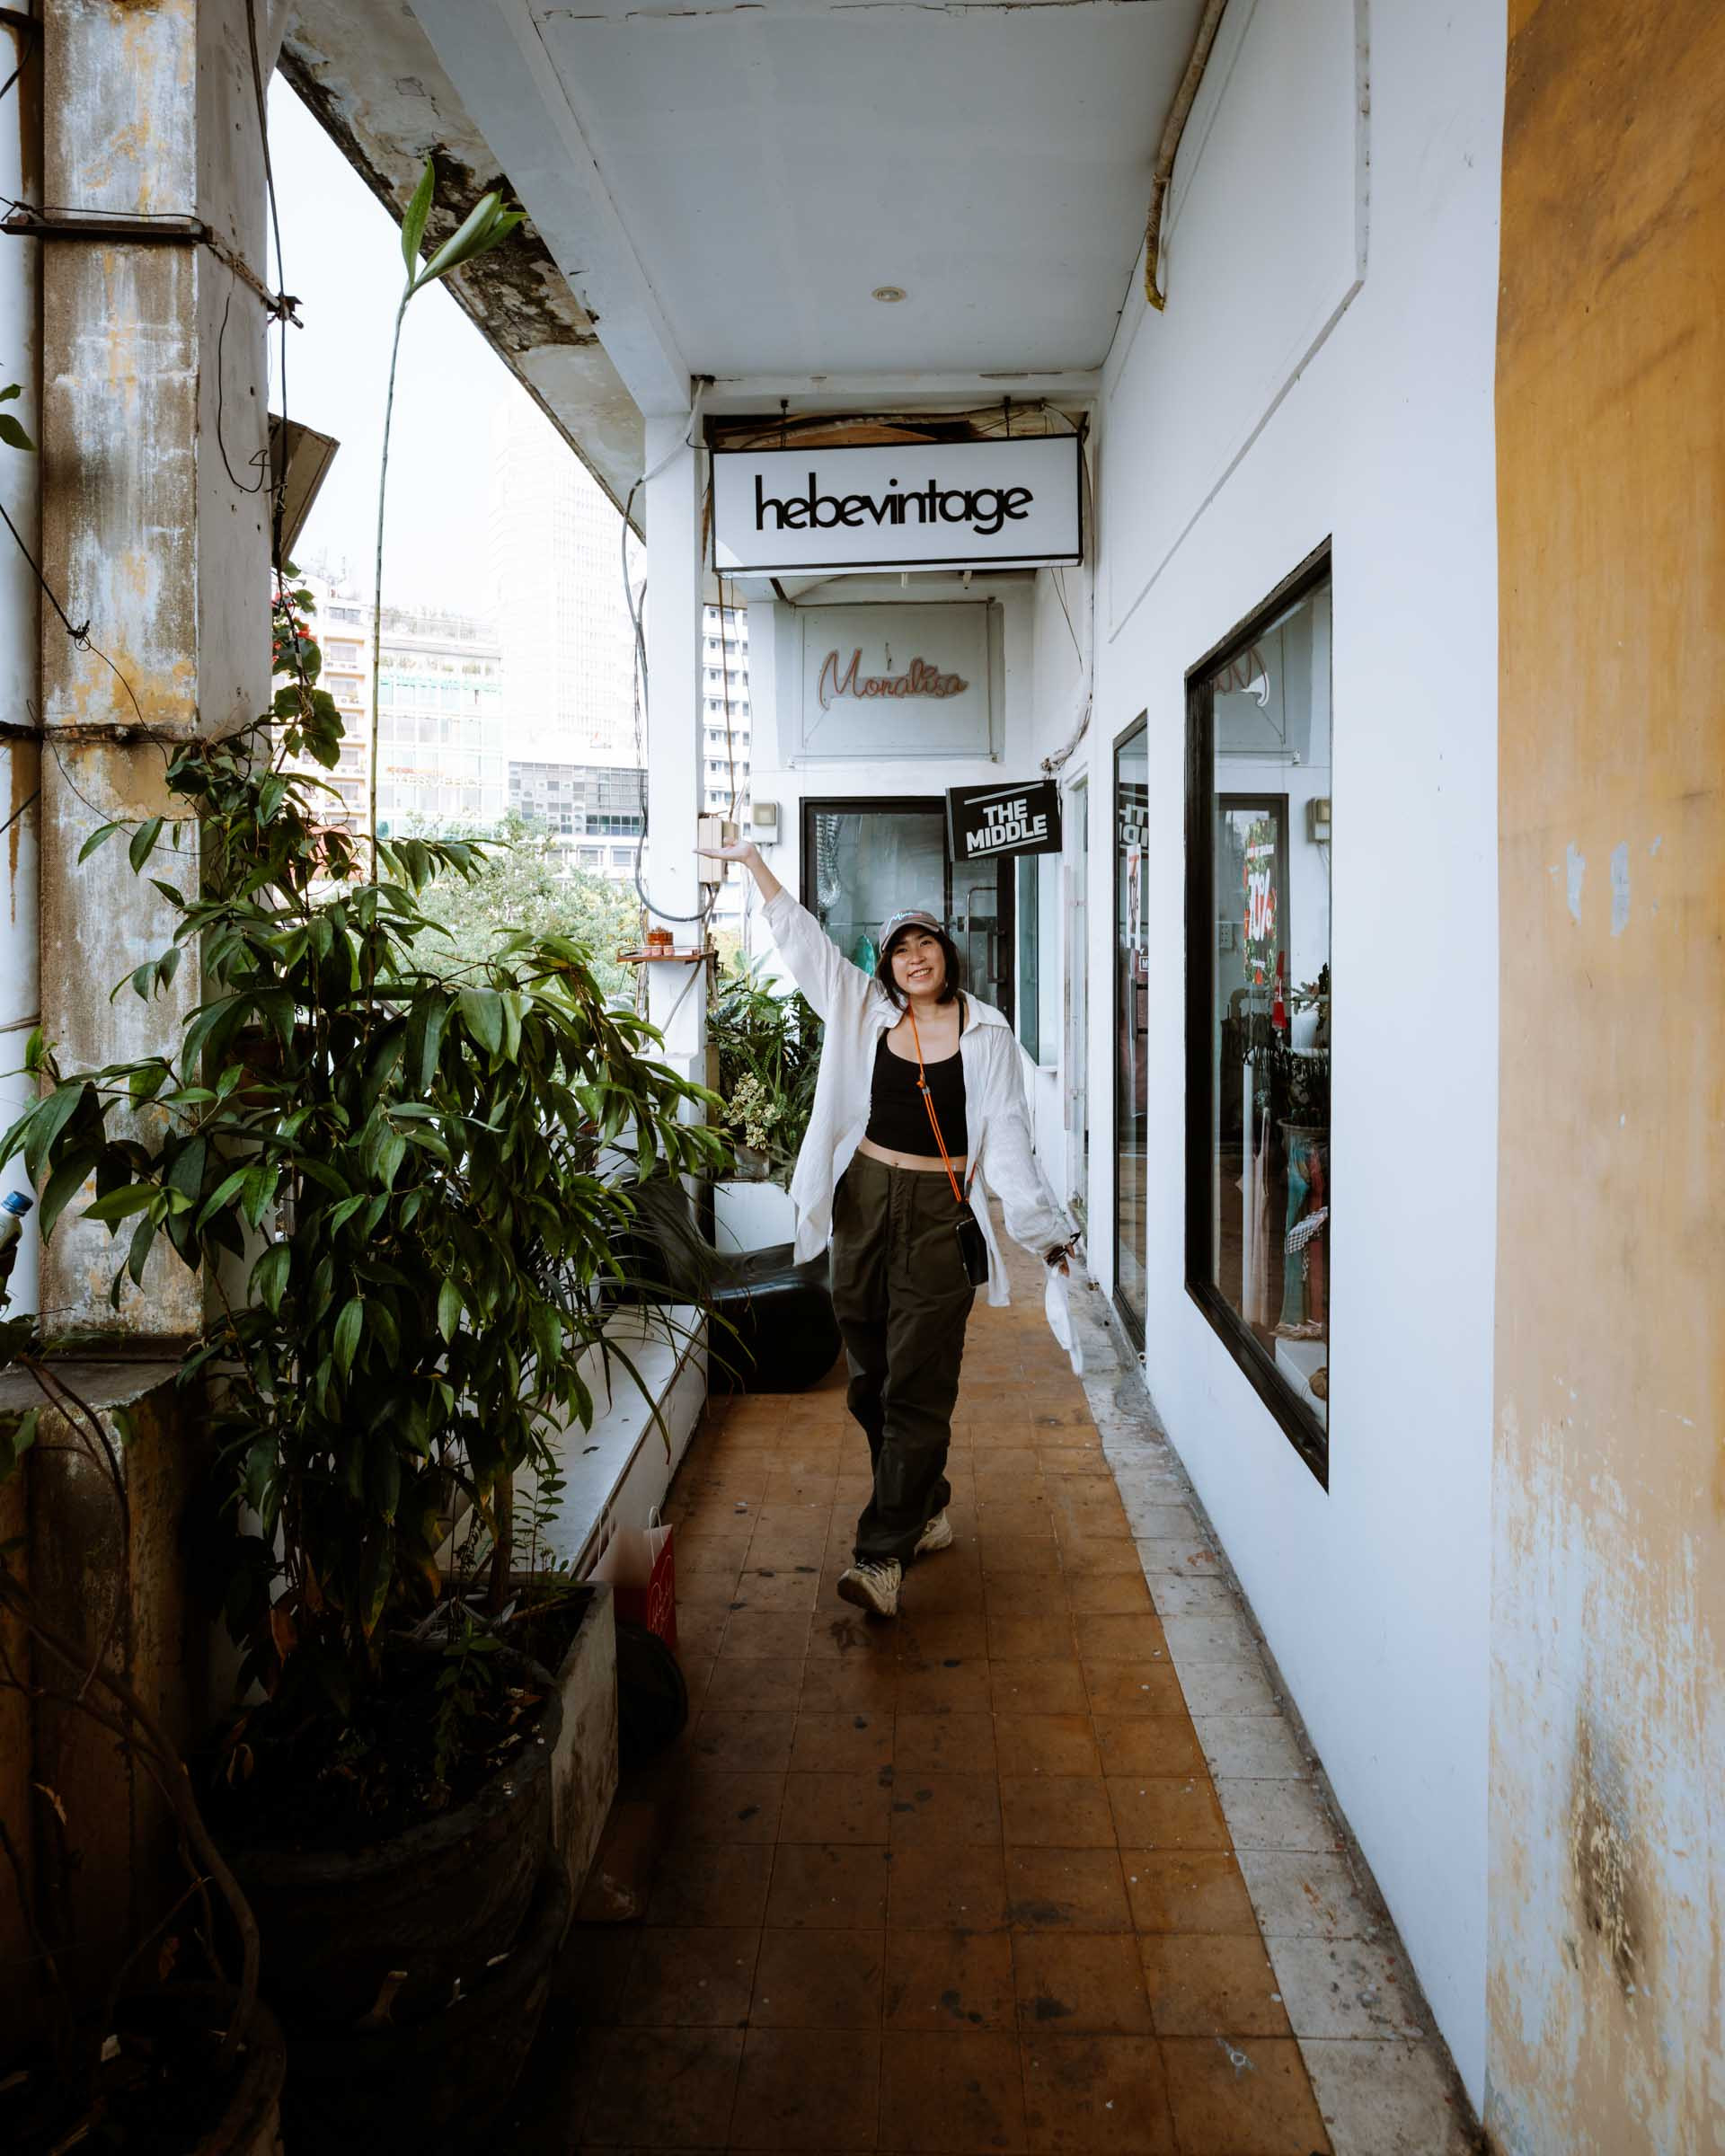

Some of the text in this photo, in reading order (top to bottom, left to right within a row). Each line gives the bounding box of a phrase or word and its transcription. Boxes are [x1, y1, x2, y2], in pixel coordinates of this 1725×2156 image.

[755, 472, 1034, 535] hebevintage
[818, 648, 969, 711] Monalisa
[966, 813, 1048, 853] MIDDLE
[982, 798, 1029, 826] THE
